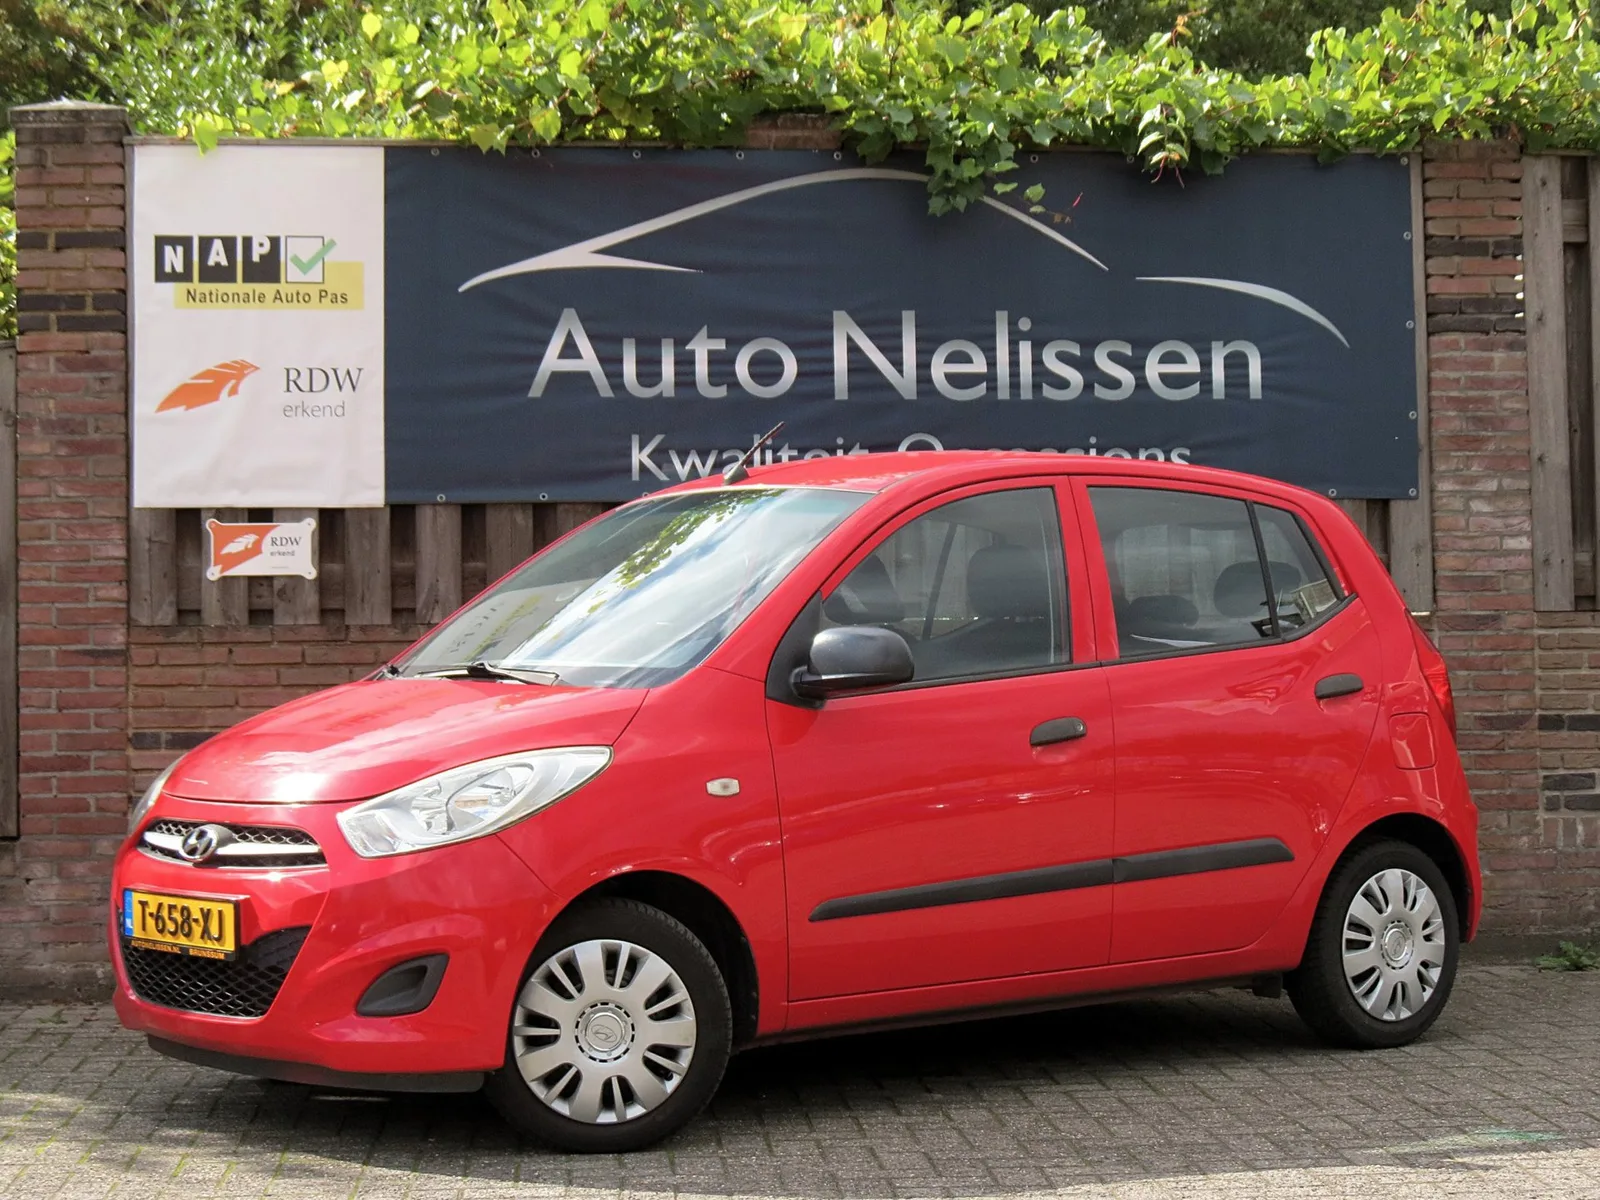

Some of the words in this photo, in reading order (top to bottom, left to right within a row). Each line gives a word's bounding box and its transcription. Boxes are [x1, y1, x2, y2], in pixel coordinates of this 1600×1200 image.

[163, 235, 271, 274] NAP
[186, 288, 266, 304] Nationale
[272, 289, 312, 304] Auto
[318, 289, 349, 304] Pas
[527, 307, 798, 399] Auto
[832, 309, 1263, 401] Nelissen
[283, 366, 364, 394] RDW
[283, 400, 346, 418] erkend
[270, 536, 302, 547] RDW
[137, 899, 224, 942] T-658-XJ
